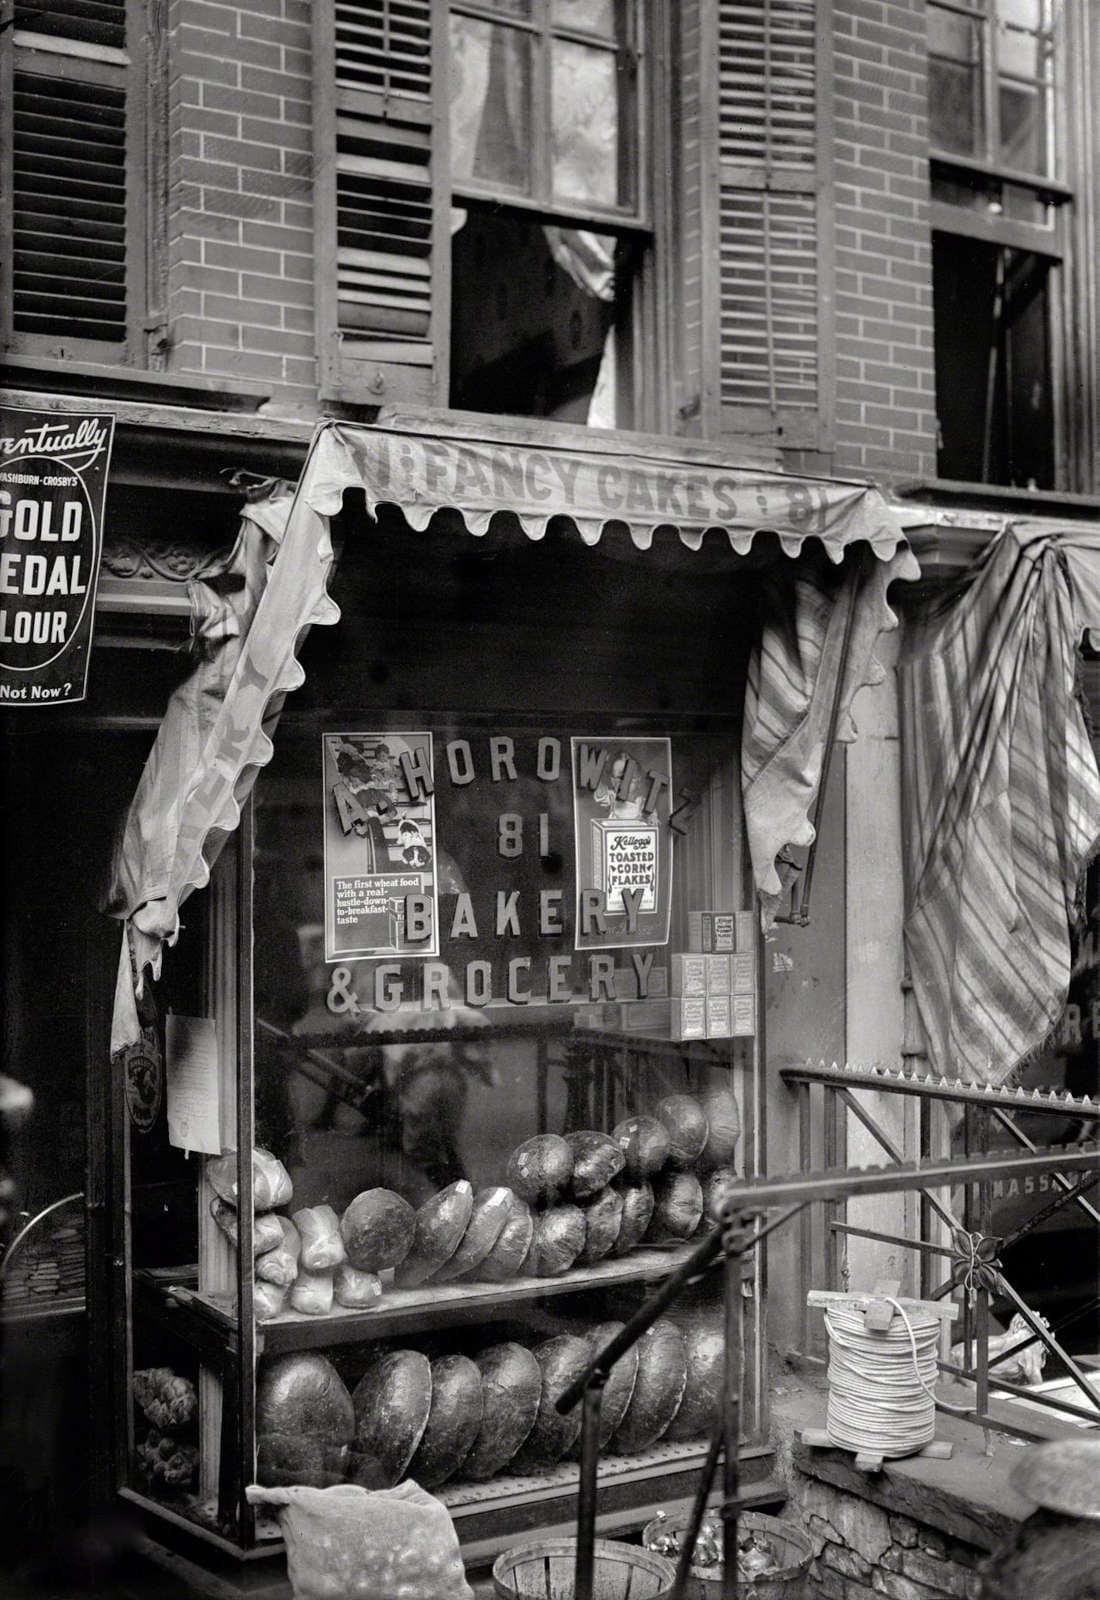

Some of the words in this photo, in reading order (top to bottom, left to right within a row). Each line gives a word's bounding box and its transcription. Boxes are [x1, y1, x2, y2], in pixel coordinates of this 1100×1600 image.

[0, 418, 107, 471] entually
[421, 443, 581, 505] FANCY
[597, 465, 737, 521] CAKES
[0, 491, 83, 542] GOLD
[0, 553, 86, 595] EDAL
[0, 610, 68, 644] LOUR
[0, 685, 27, 699] Not
[499, 813, 549, 858] 81
[609, 852, 654, 863] TOASTED
[617, 864, 646, 874] CORN
[336, 881, 353, 890] The
[354, 880, 373, 889] first
[374, 879, 398, 888] wheat
[400, 878, 419, 887] food
[336, 889, 357, 898] with
[612, 875, 651, 886] FLAKES
[336, 916, 358, 925] taste
[404, 887, 645, 942] BAKERY
[326, 966, 361, 1018] &
[374, 953, 654, 1012] GROCERY
